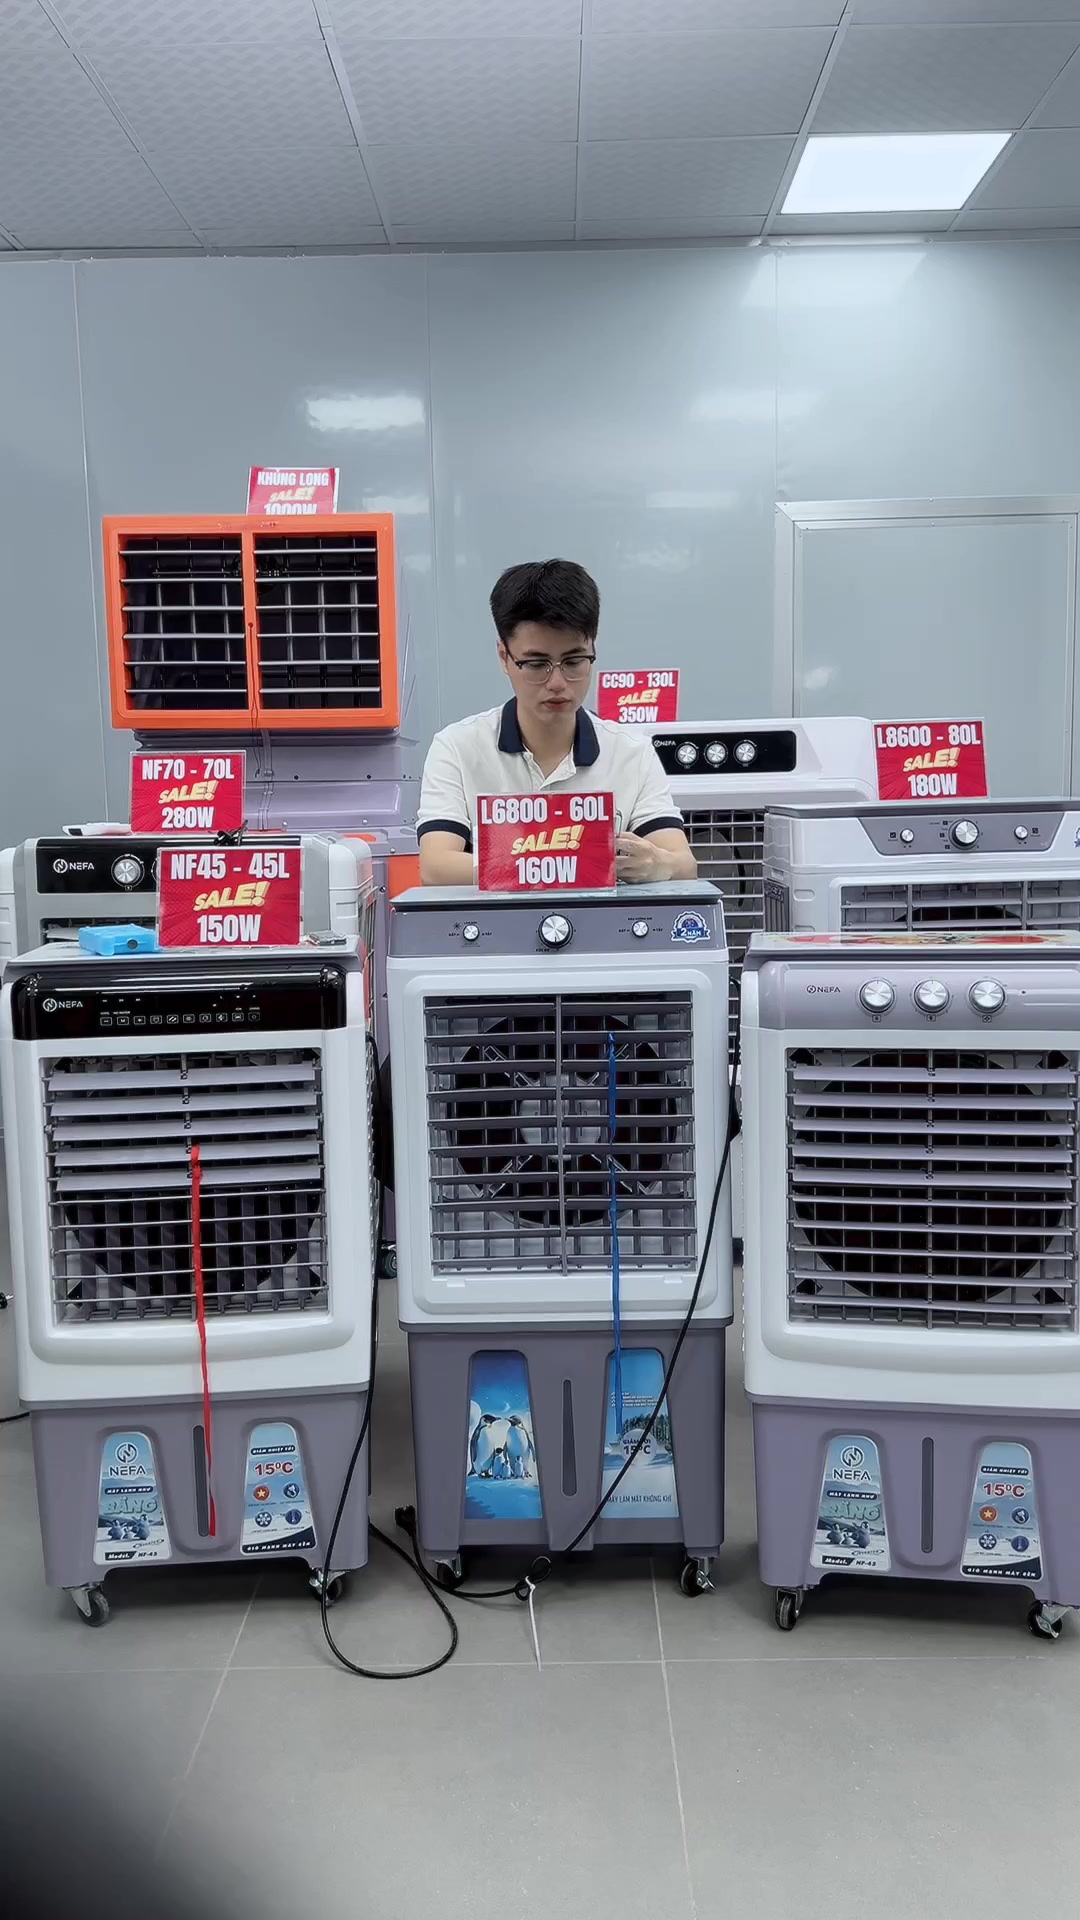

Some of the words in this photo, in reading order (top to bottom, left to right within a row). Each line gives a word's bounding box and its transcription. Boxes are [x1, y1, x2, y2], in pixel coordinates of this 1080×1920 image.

[300, 472, 329, 487] LONG
[268, 486, 317, 503] SALE!
[602, 672, 635, 688] CC90
[646, 671, 676, 688] 130L
[617, 688, 661, 706] SALE!
[618, 706, 659, 723] 350W
[876, 724, 932, 748] L8600
[948, 724, 981, 746] 80L
[142, 759, 186, 780] NF70
[202, 758, 235, 779] 70L
[902, 747, 961, 772] SALE!
[158, 780, 219, 804] SALE!
[907, 773, 958, 797] 180W
[161, 806, 215, 829] 280W
[481, 797, 548, 825] L6800
[569, 796, 609, 822] 60L
[510, 824, 585, 856] SALE!
[69, 861, 95, 870] NEFA
[170, 853, 226, 880] NF45
[248, 852, 290, 879] 45L
[515, 855, 578, 885] 160W
[193, 881, 270, 911] SALE!
[196, 914, 261, 943] 150W
[680, 928, 687, 936] 2
[58, 1000, 84, 1009] NEFA
[109, 1464, 147, 1477] NEFA
[833, 1468, 872, 1481] NEFA
